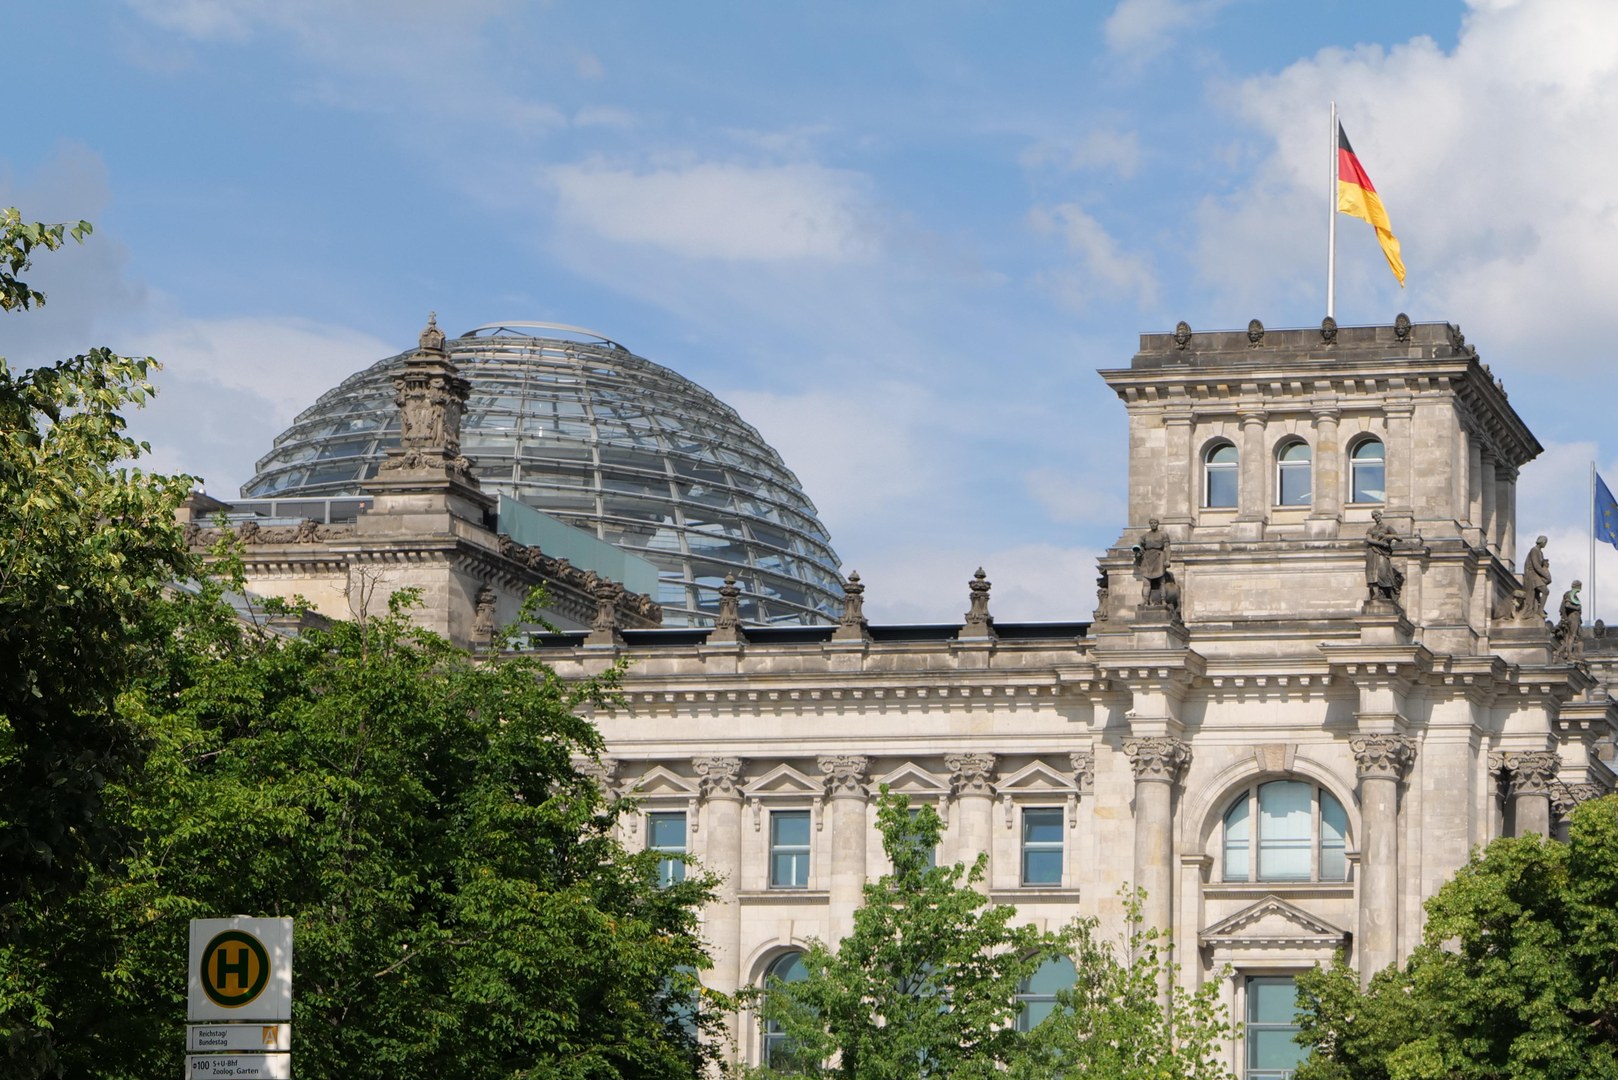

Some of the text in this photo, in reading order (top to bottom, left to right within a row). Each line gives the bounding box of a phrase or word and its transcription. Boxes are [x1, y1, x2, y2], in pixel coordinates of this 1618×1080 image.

[216, 948, 249, 989] H
[199, 1030, 277, 1045] Reichstag/ A
[199, 1038, 228, 1047] Bundestag
[197, 1060, 238, 1071] 100 S+U-Bhf
[212, 1067, 259, 1076] Zoolog. Garten
